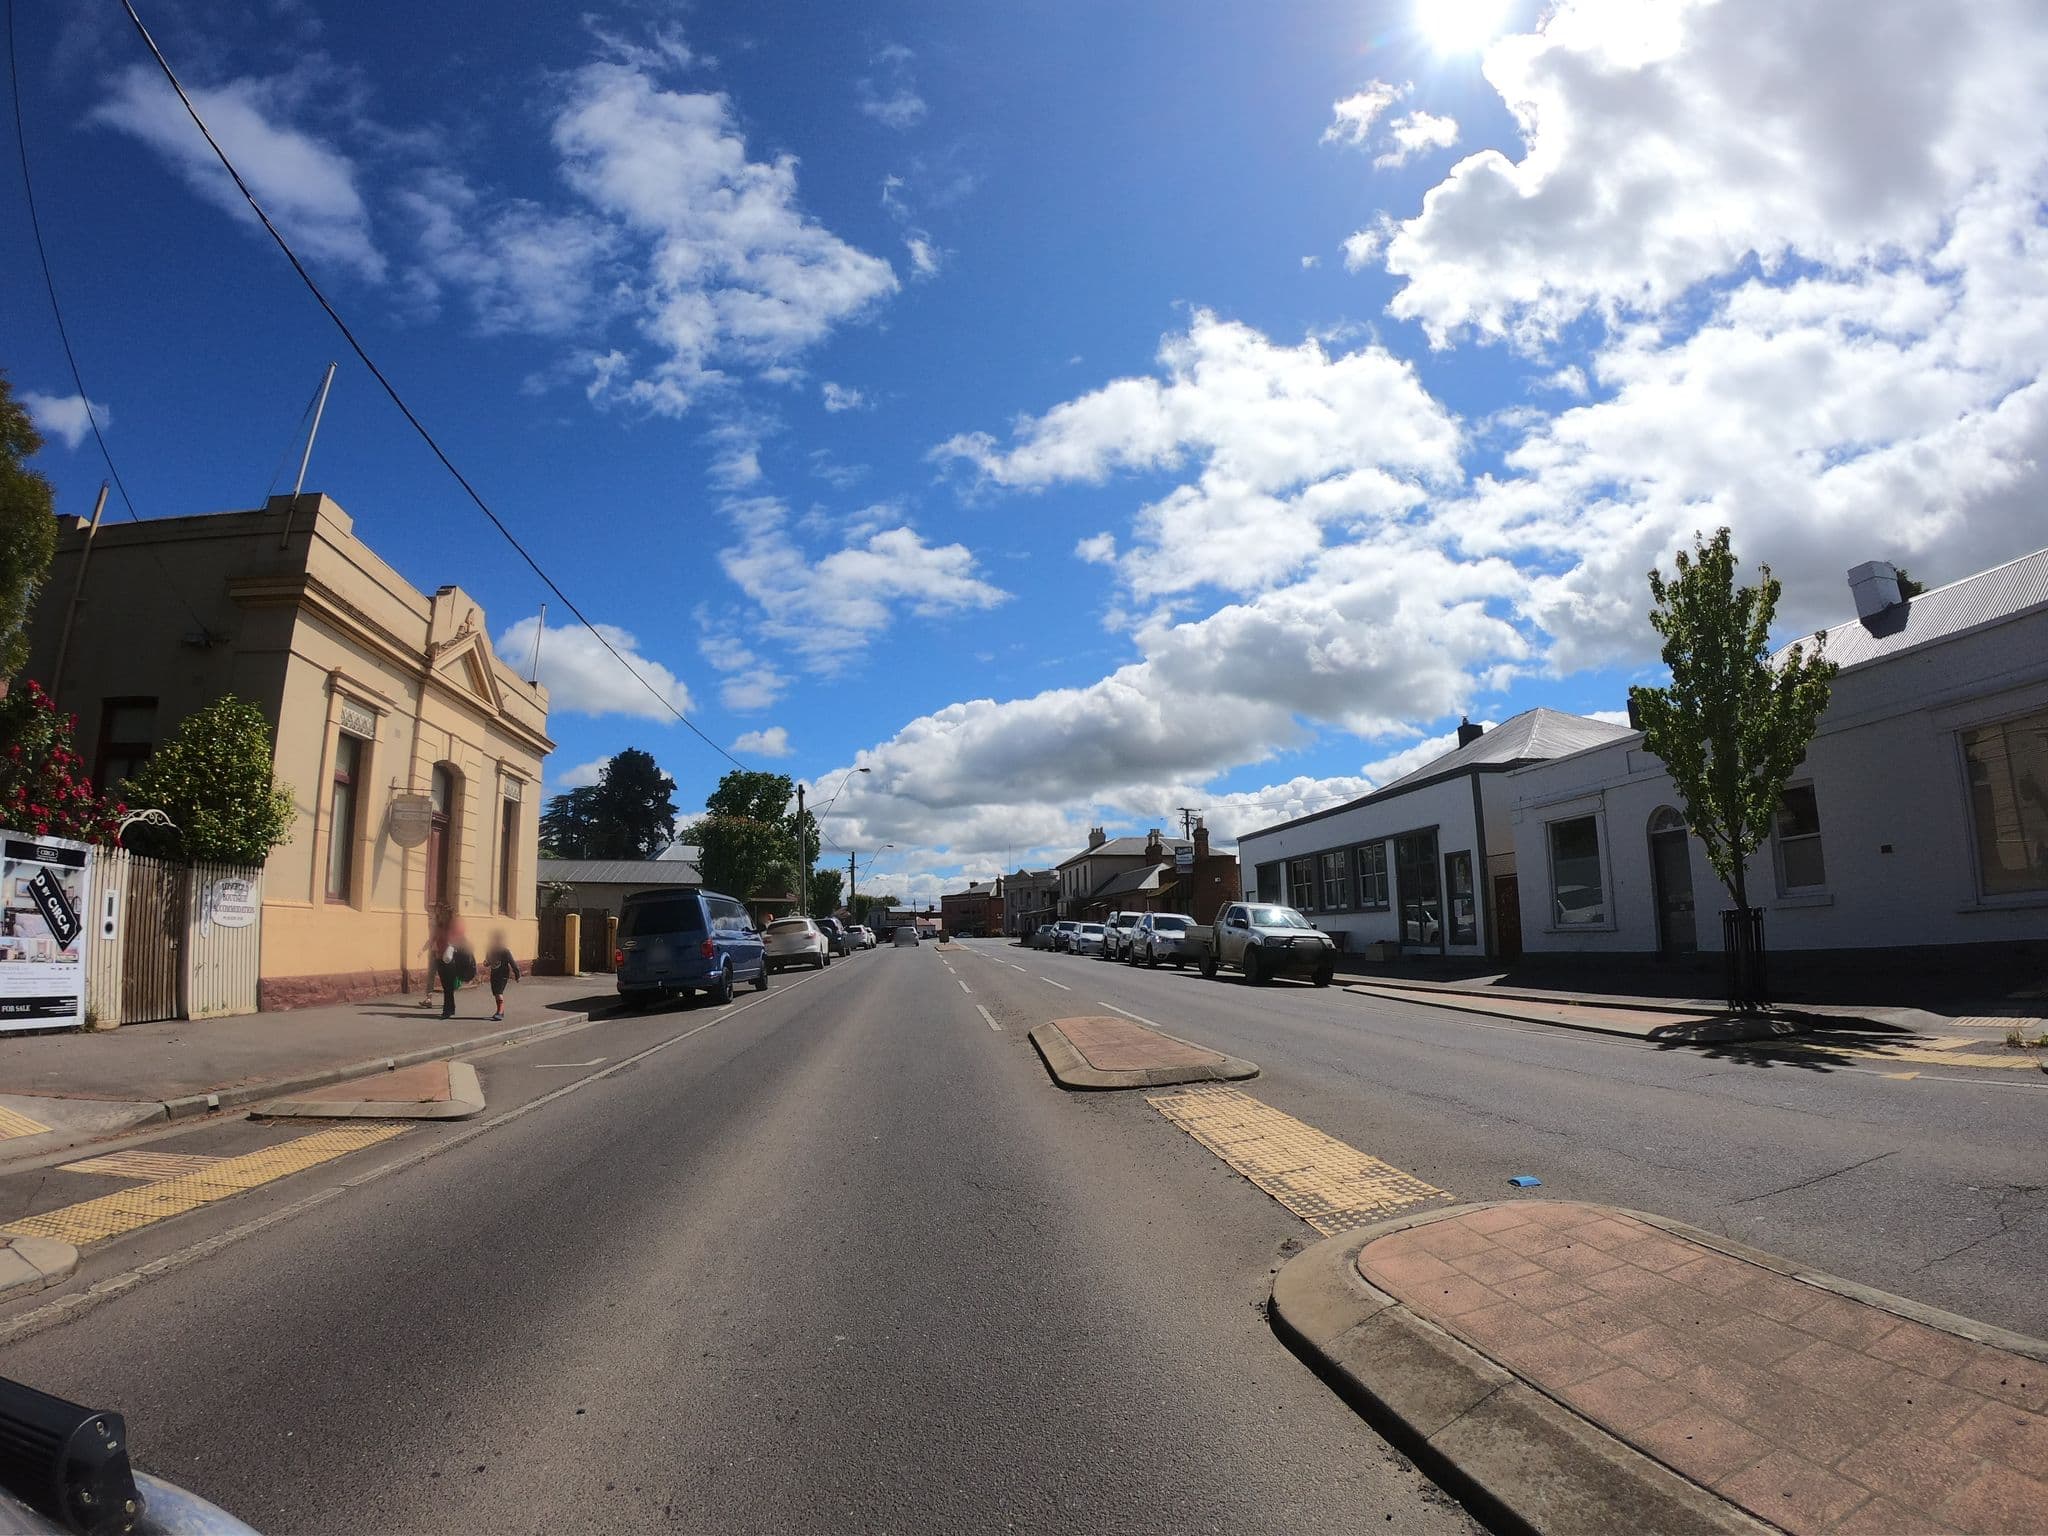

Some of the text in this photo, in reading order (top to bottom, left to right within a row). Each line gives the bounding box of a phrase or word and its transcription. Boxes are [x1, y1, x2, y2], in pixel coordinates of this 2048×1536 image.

[47, 897, 70, 935] CIRCA
[1, 1005, 15, 1013] FOR
[15, 1004, 31, 1012] SALE
